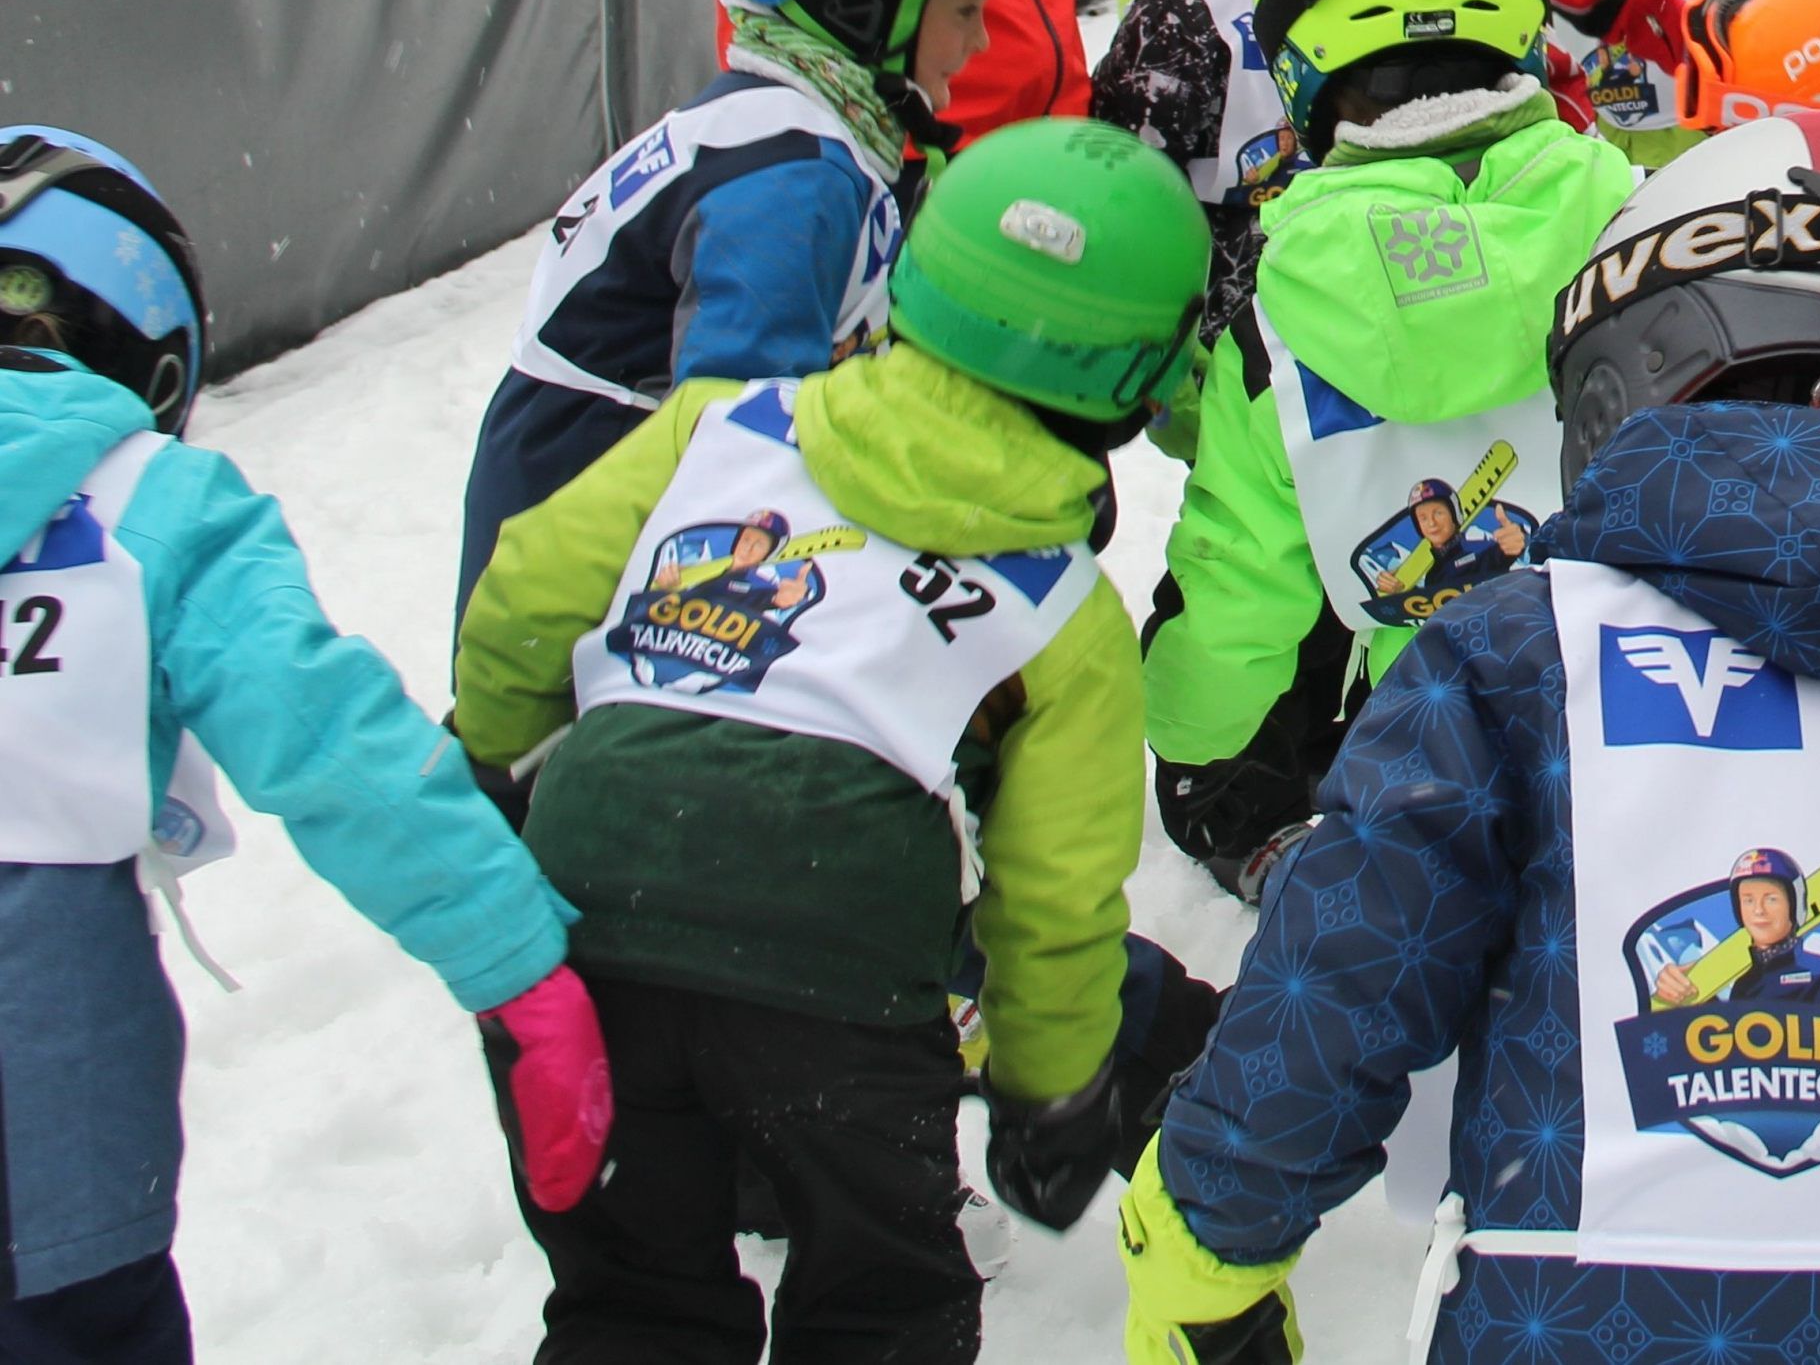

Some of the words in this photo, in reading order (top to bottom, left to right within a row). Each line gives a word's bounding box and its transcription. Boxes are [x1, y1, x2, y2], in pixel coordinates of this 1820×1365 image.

[1590, 85, 1641, 105] GOLDI
[648, 593, 763, 652] GOLDI
[898, 550, 998, 646] 52
